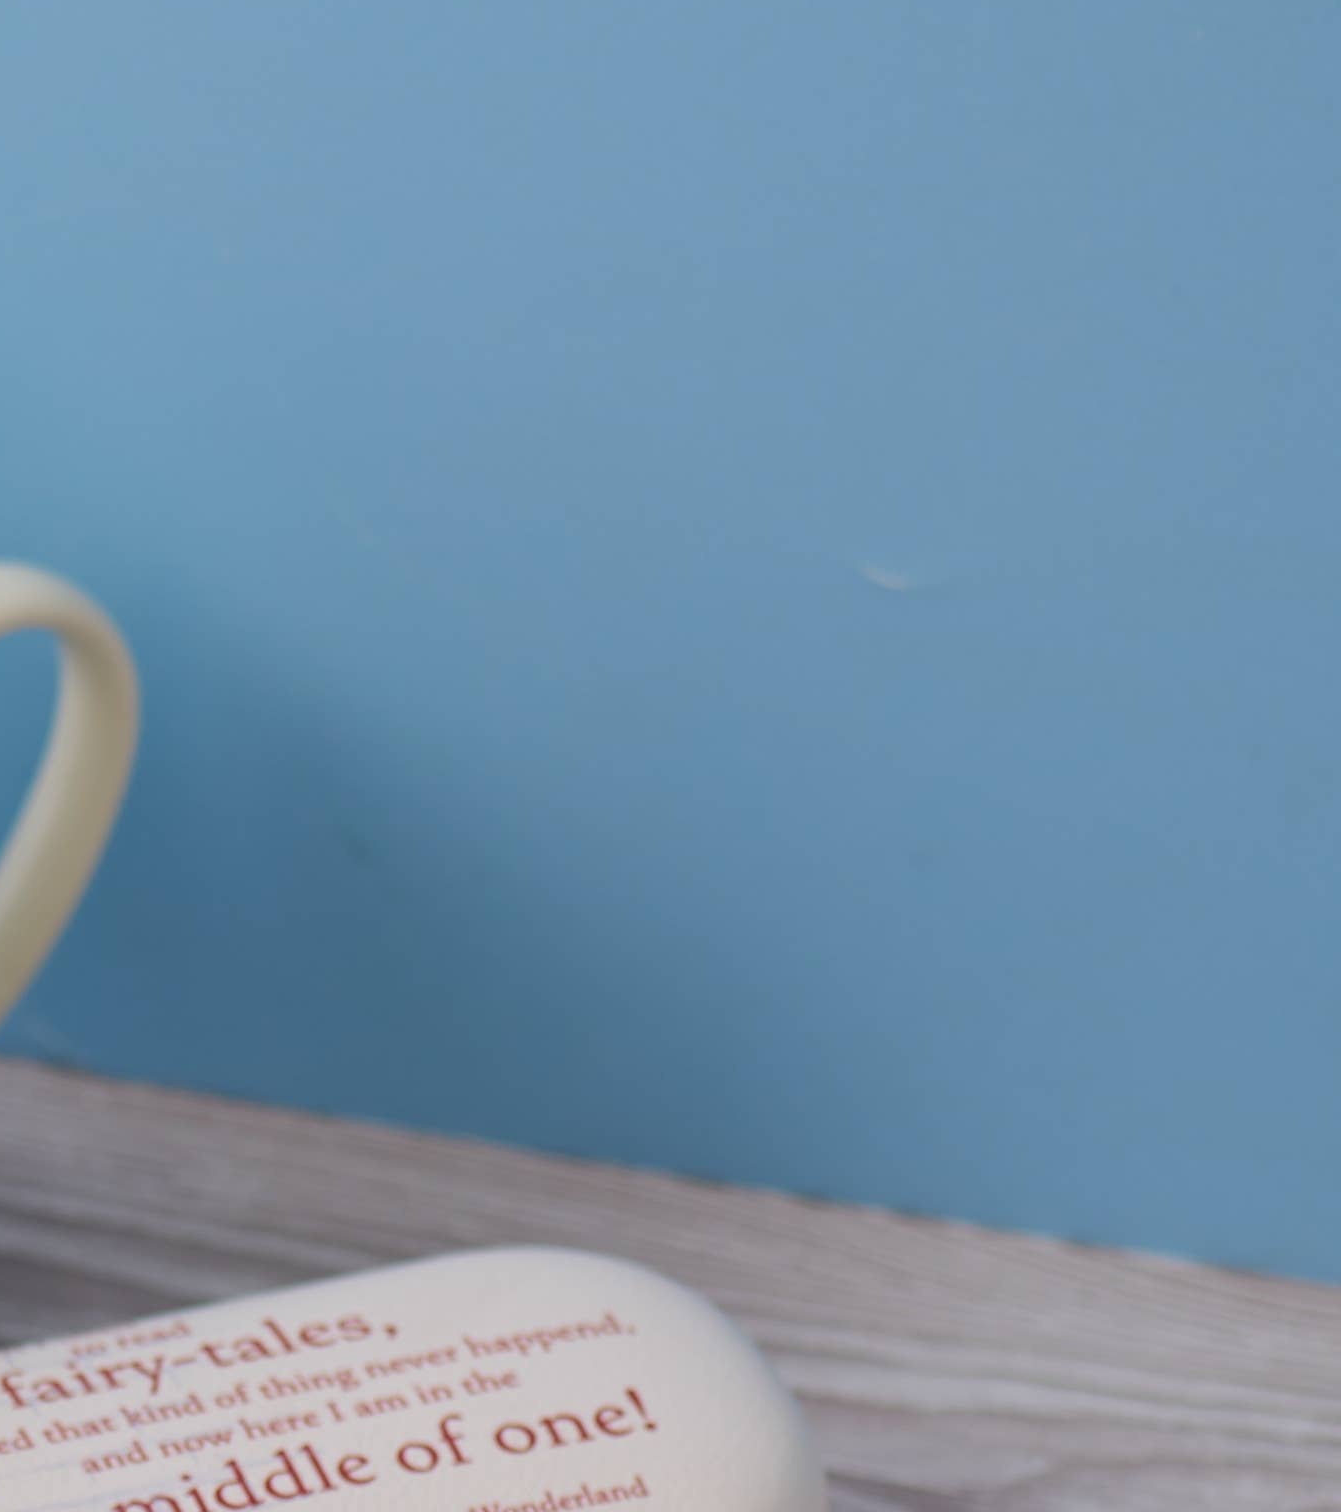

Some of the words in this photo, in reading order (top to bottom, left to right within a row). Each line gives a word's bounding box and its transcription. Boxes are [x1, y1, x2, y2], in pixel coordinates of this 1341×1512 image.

[0, 1313, 399, 1409] fairy-tales,
[42, 1418, 115, 1444] that
[120, 1392, 205, 1429] kind
[213, 1375, 249, 1410] of
[258, 1363, 358, 1401] thing
[364, 1346, 459, 1379] never
[81, 1440, 149, 1474] and
[159, 1430, 234, 1458] now
[239, 1403, 320, 1443] here
[327, 1400, 344, 1423] I
[354, 1392, 409, 1418] am
[417, 1383, 453, 1406] in
[461, 1366, 519, 1396] the
[396, 1412, 473, 1475] of
[494, 1386, 658, 1455] one!
